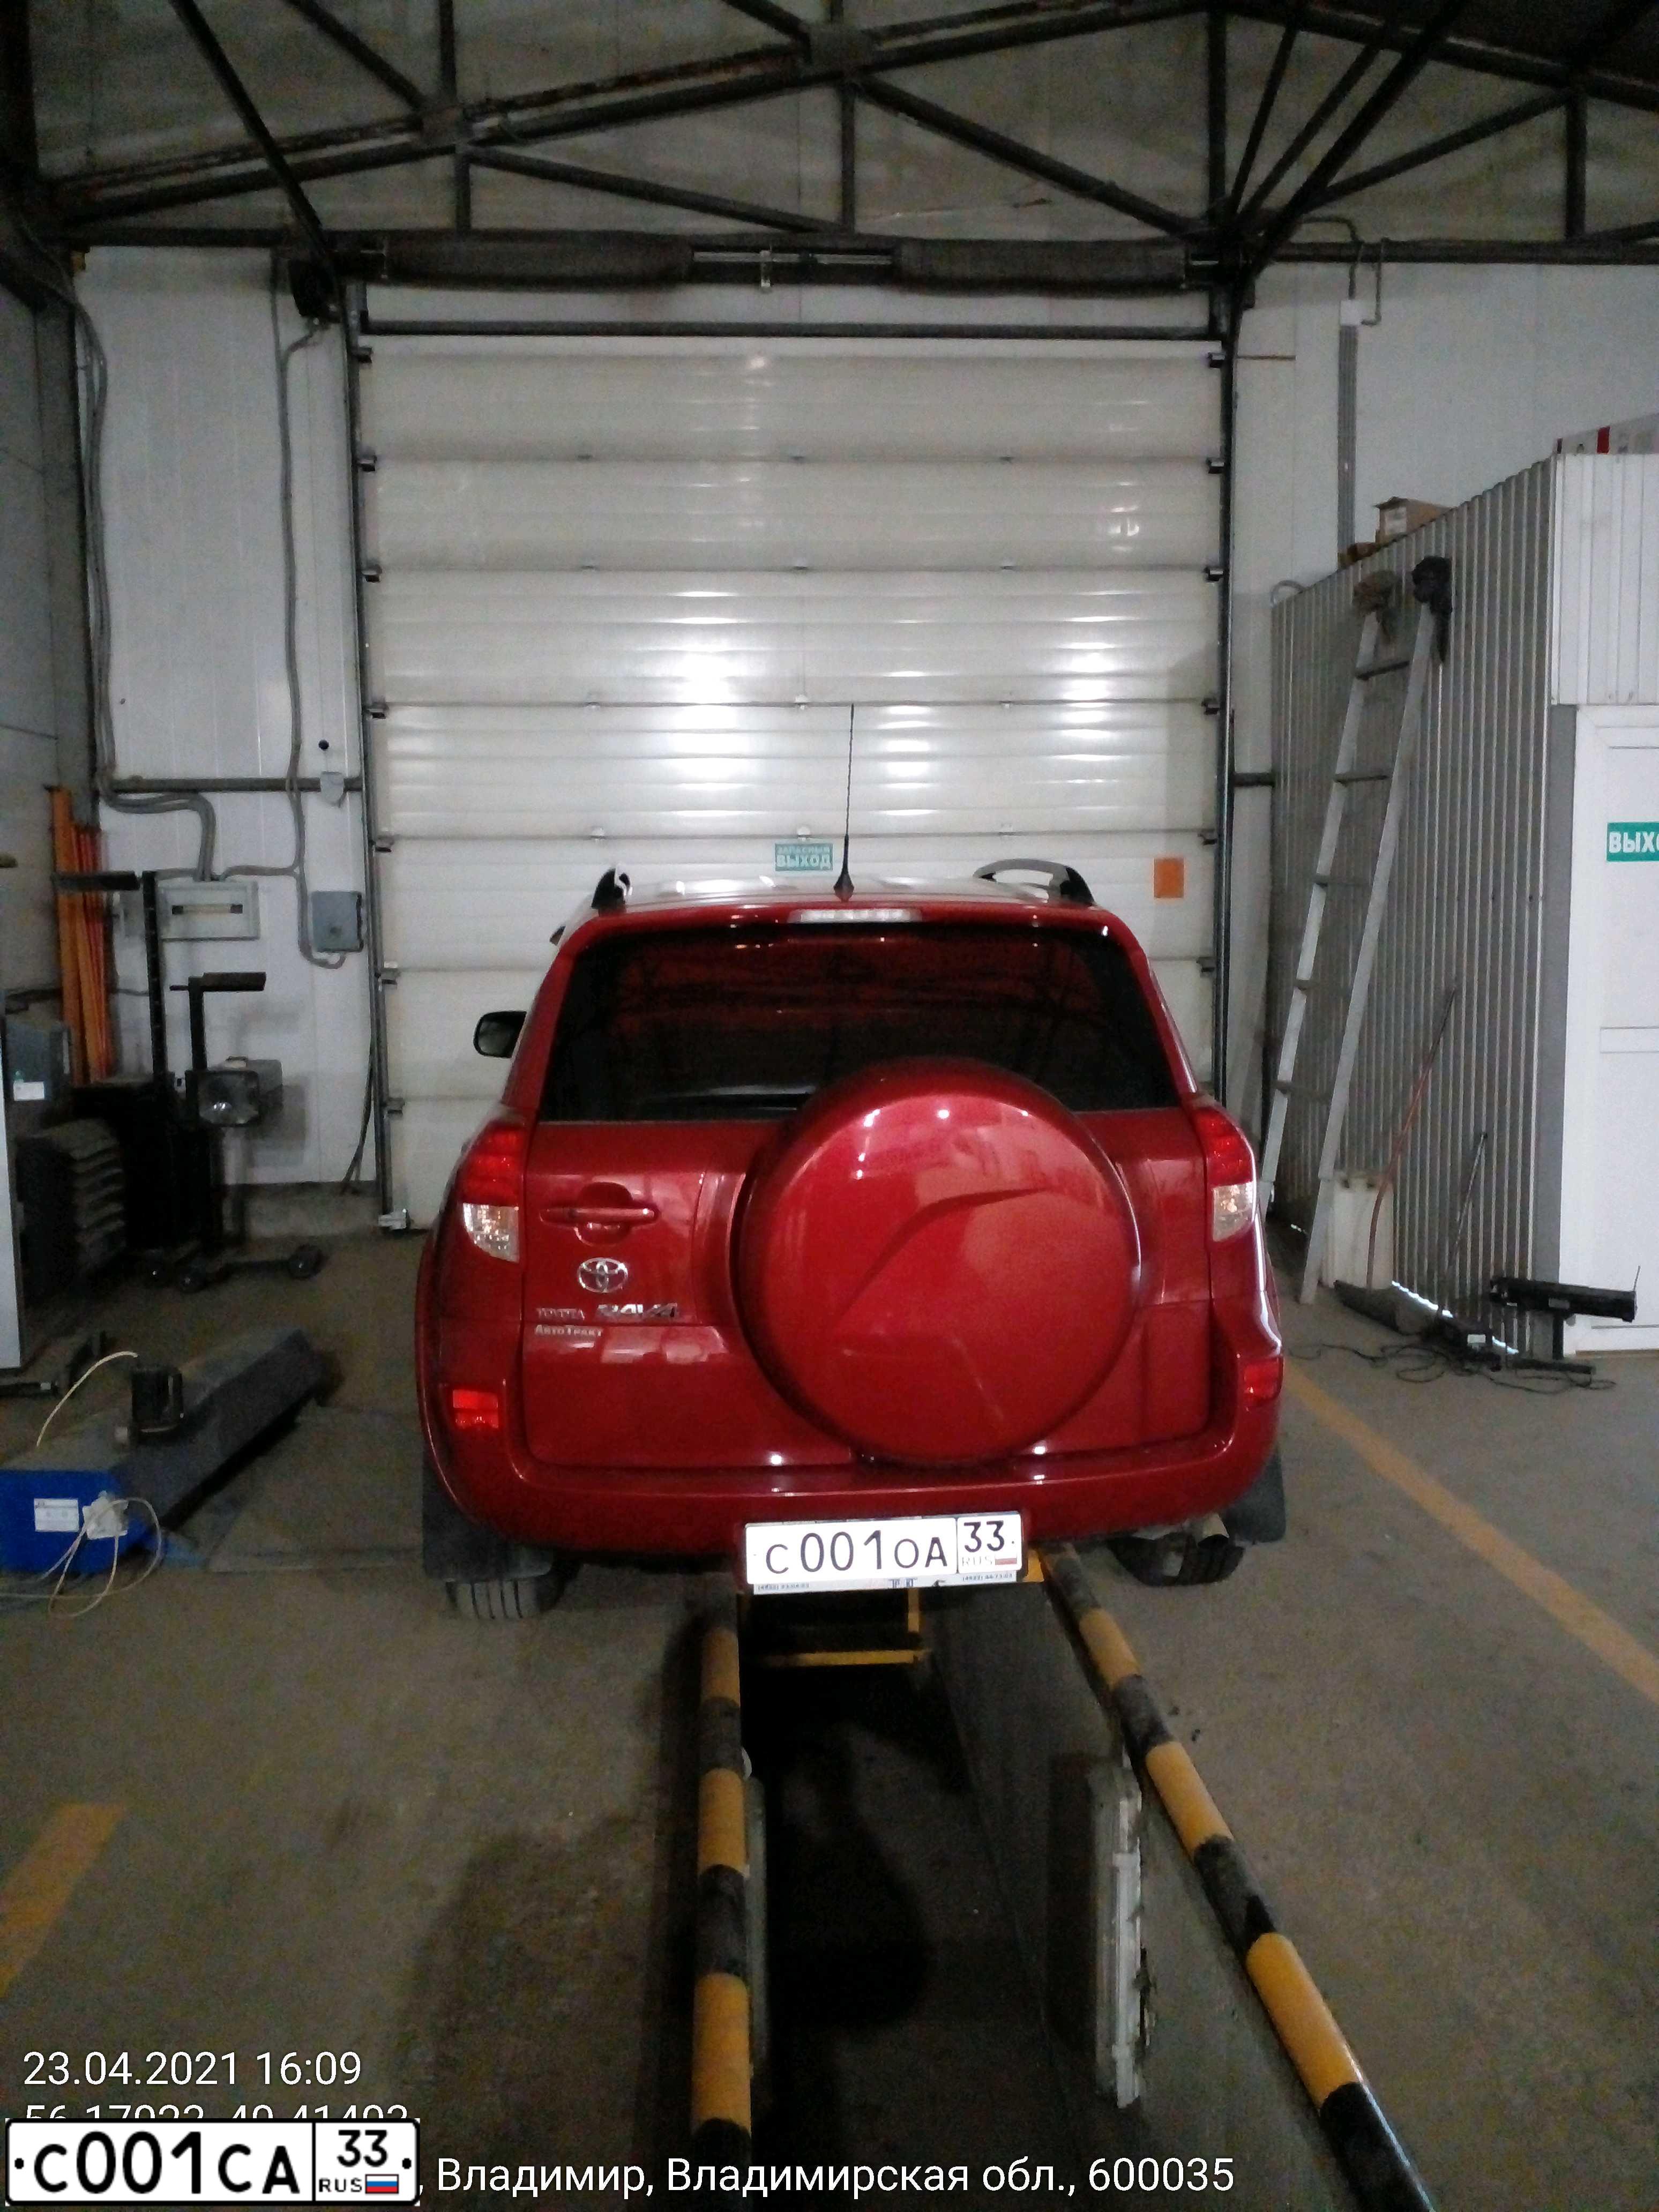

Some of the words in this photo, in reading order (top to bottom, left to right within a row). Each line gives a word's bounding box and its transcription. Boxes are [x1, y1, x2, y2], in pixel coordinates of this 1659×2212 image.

[1609, 831, 1659, 853] ВЫХ
[776, 854, 830, 869] ВЫХОД
[963, 1520, 1004, 1552] 33
